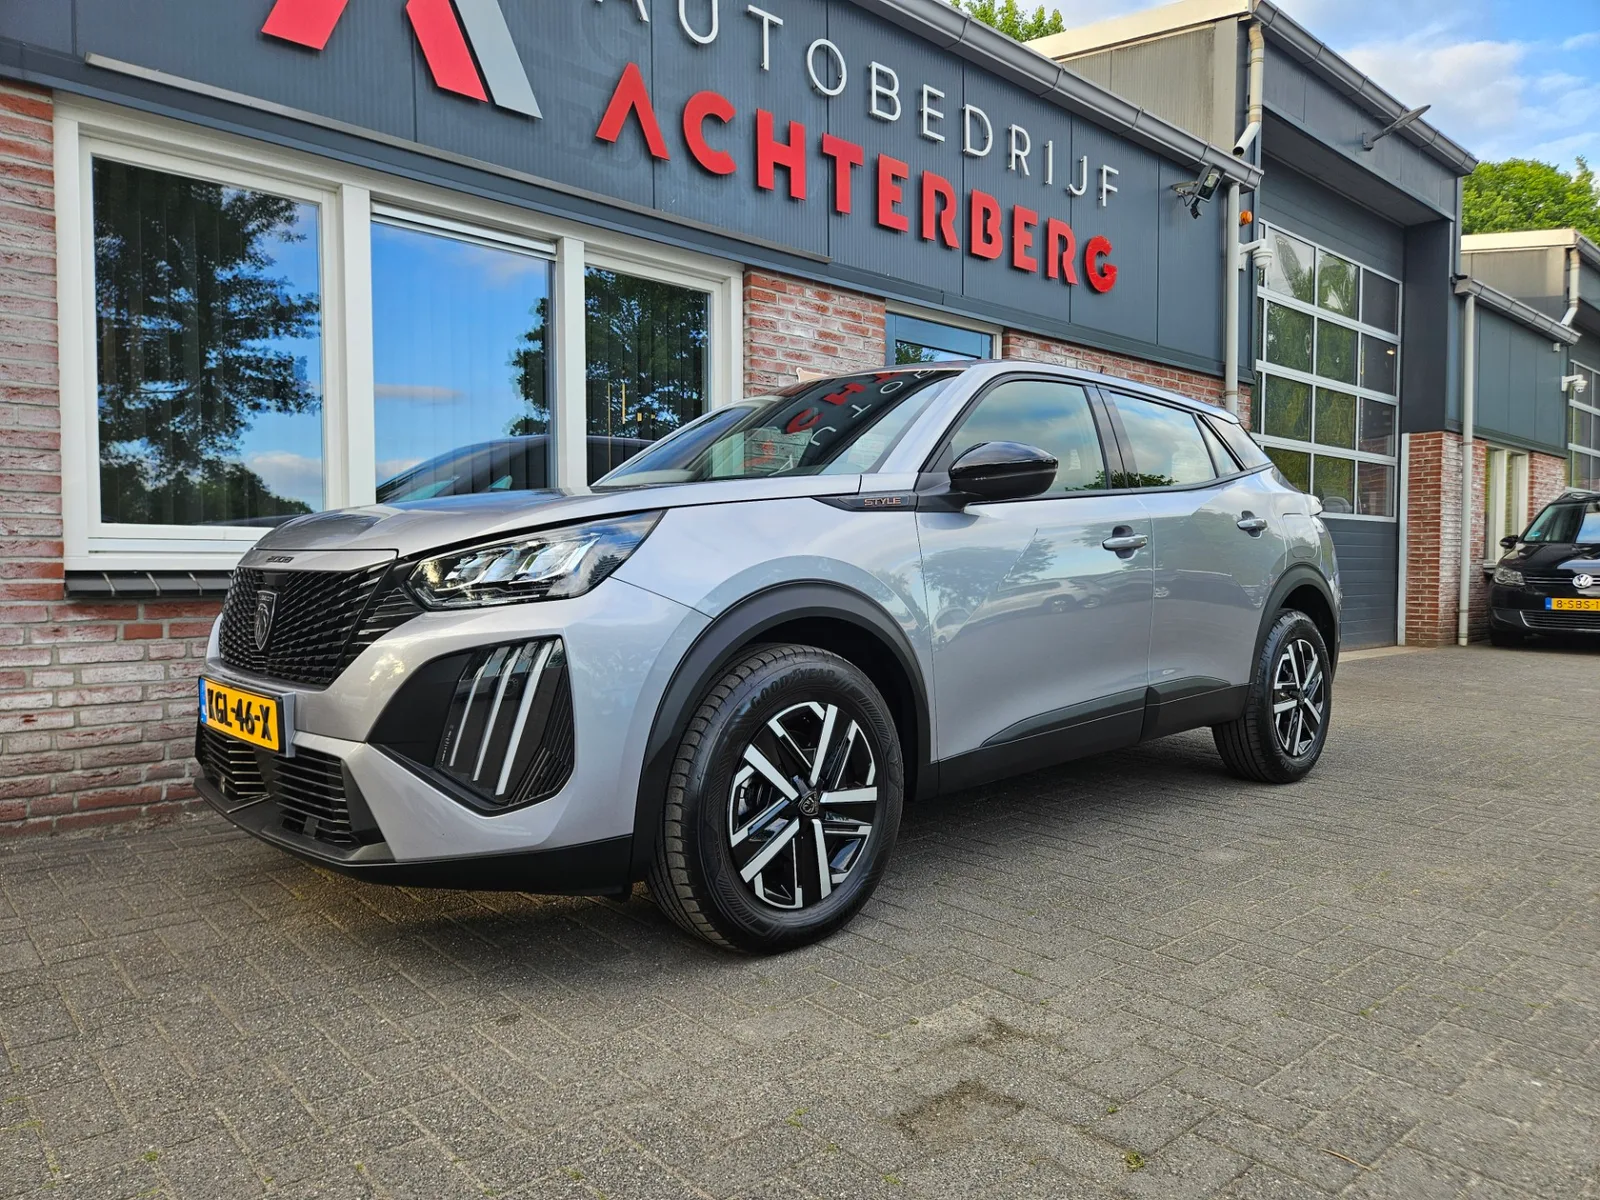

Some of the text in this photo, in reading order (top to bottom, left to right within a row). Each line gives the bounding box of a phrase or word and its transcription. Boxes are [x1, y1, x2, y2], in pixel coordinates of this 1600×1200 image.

[594, 0, 1119, 207] UTOBEDRIJF
[595, 62, 1118, 294] ACHTERBERG
[864, 496, 901, 507] STYLE
[207, 688, 273, 742] KGL-46-X
